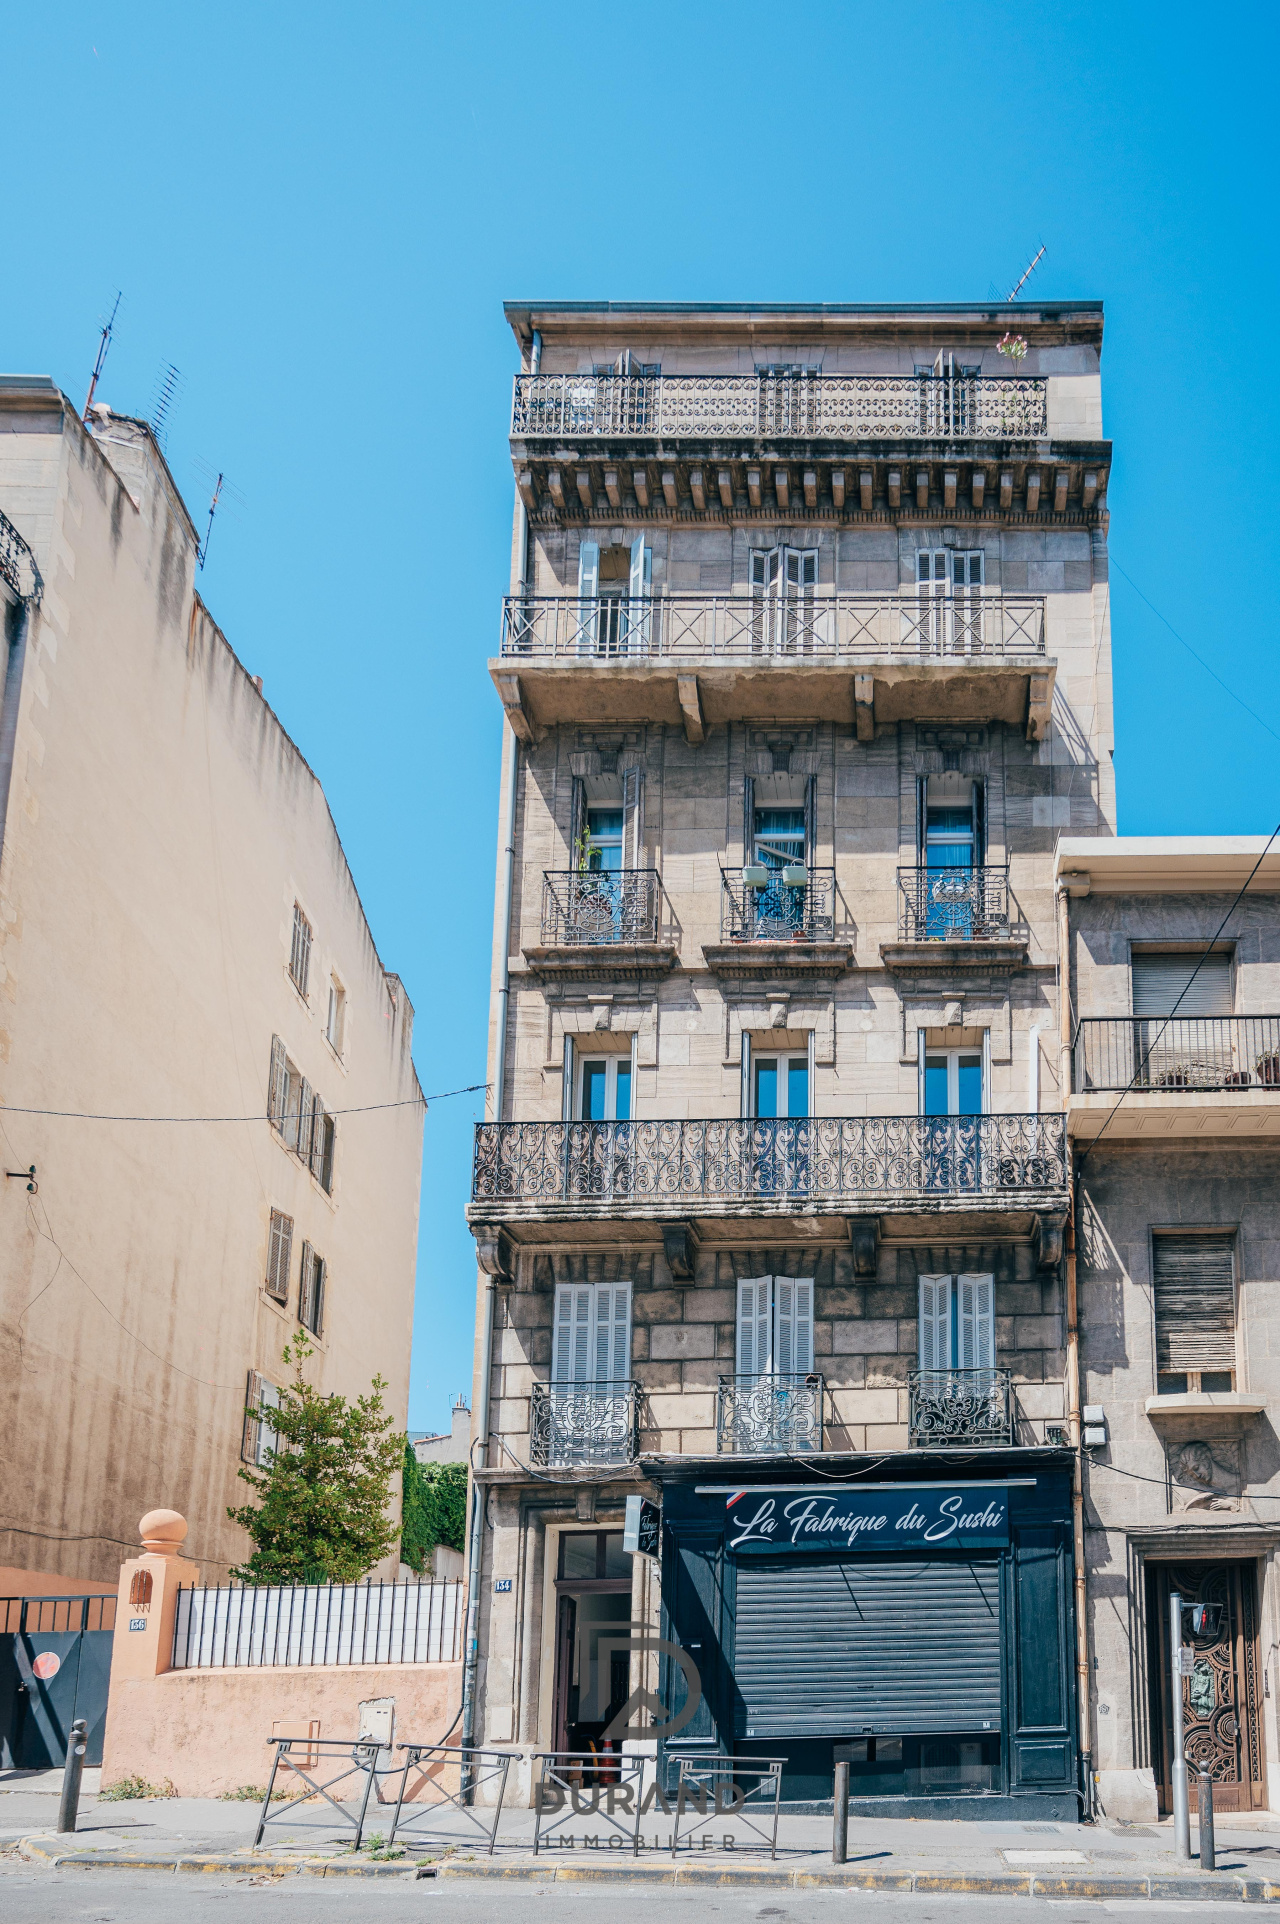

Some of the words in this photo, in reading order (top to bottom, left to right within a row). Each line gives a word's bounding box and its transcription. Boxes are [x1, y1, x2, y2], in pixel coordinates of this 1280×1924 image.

[730, 1499, 778, 1548] La
[783, 1495, 888, 1546] Fabrique
[895, 1503, 927, 1530] du
[923, 1496, 1005, 1541] Sushi
[496, 1580, 510, 1591] 134
[130, 1619, 145, 1630] 136
